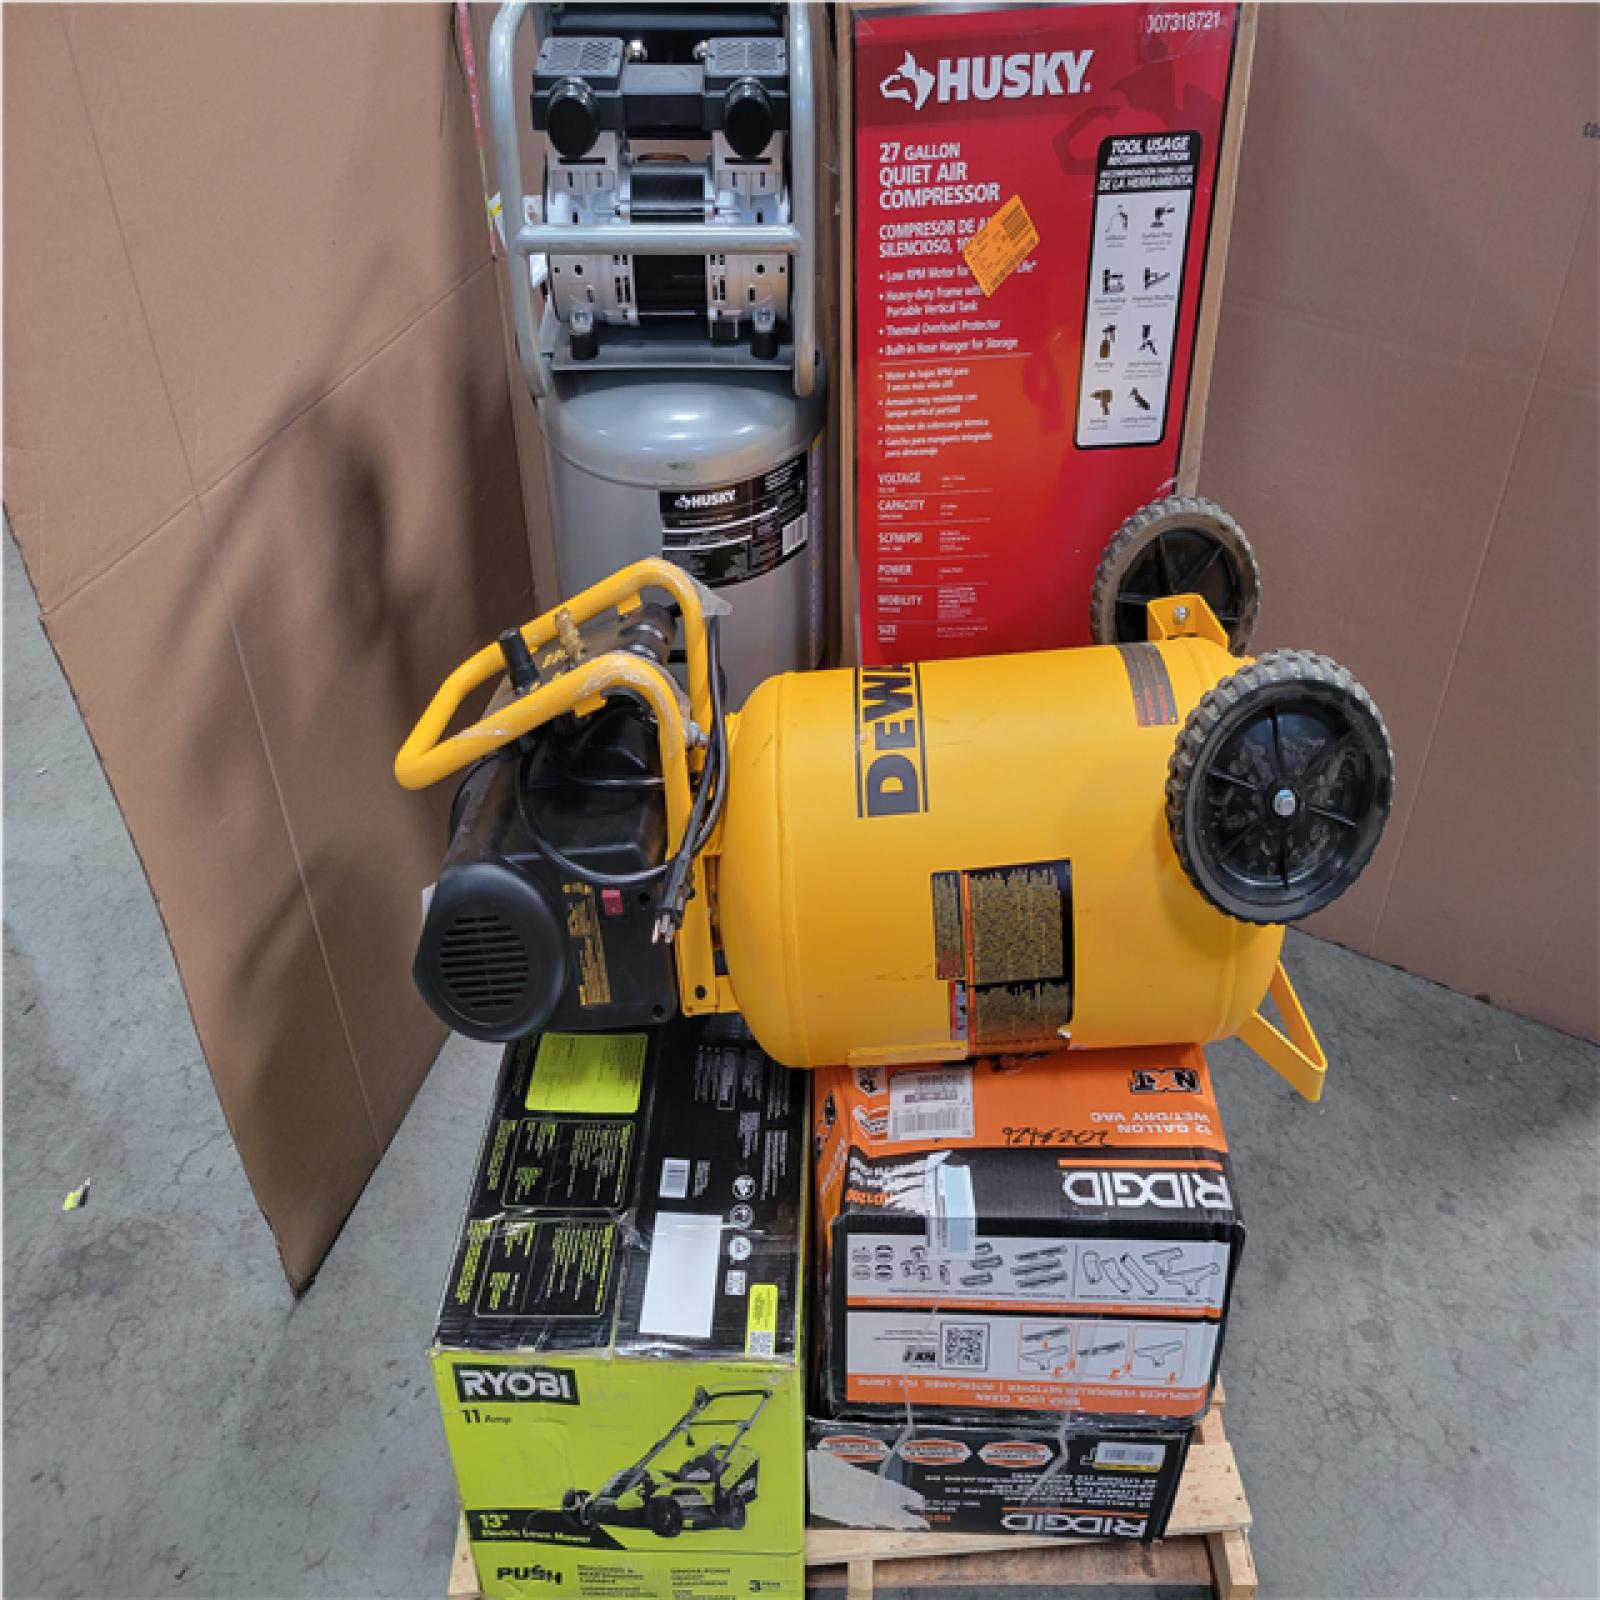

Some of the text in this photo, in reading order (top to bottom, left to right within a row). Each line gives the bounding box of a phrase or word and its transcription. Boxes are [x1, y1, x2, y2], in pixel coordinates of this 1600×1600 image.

[937, 49, 1093, 103] HUSKY
[879, 141, 961, 163] 27 GALLON
[879, 161, 969, 188] QUIET AIR
[879, 182, 1001, 211] COMPRESSOR
[879, 219, 956, 241] COMPRESOR
[959, 217, 976, 234] DE
[692, 489, 736, 507] HUSKY
[1117, 1122, 1190, 1134] GALLON
[1062, 1171, 1233, 1211] RIDGID
[460, 1370, 571, 1399] RYOBI
[461, 1408, 481, 1424] 11
[1001, 1513, 1149, 1538] RIDGID
[497, 1565, 562, 1585] PUSH
